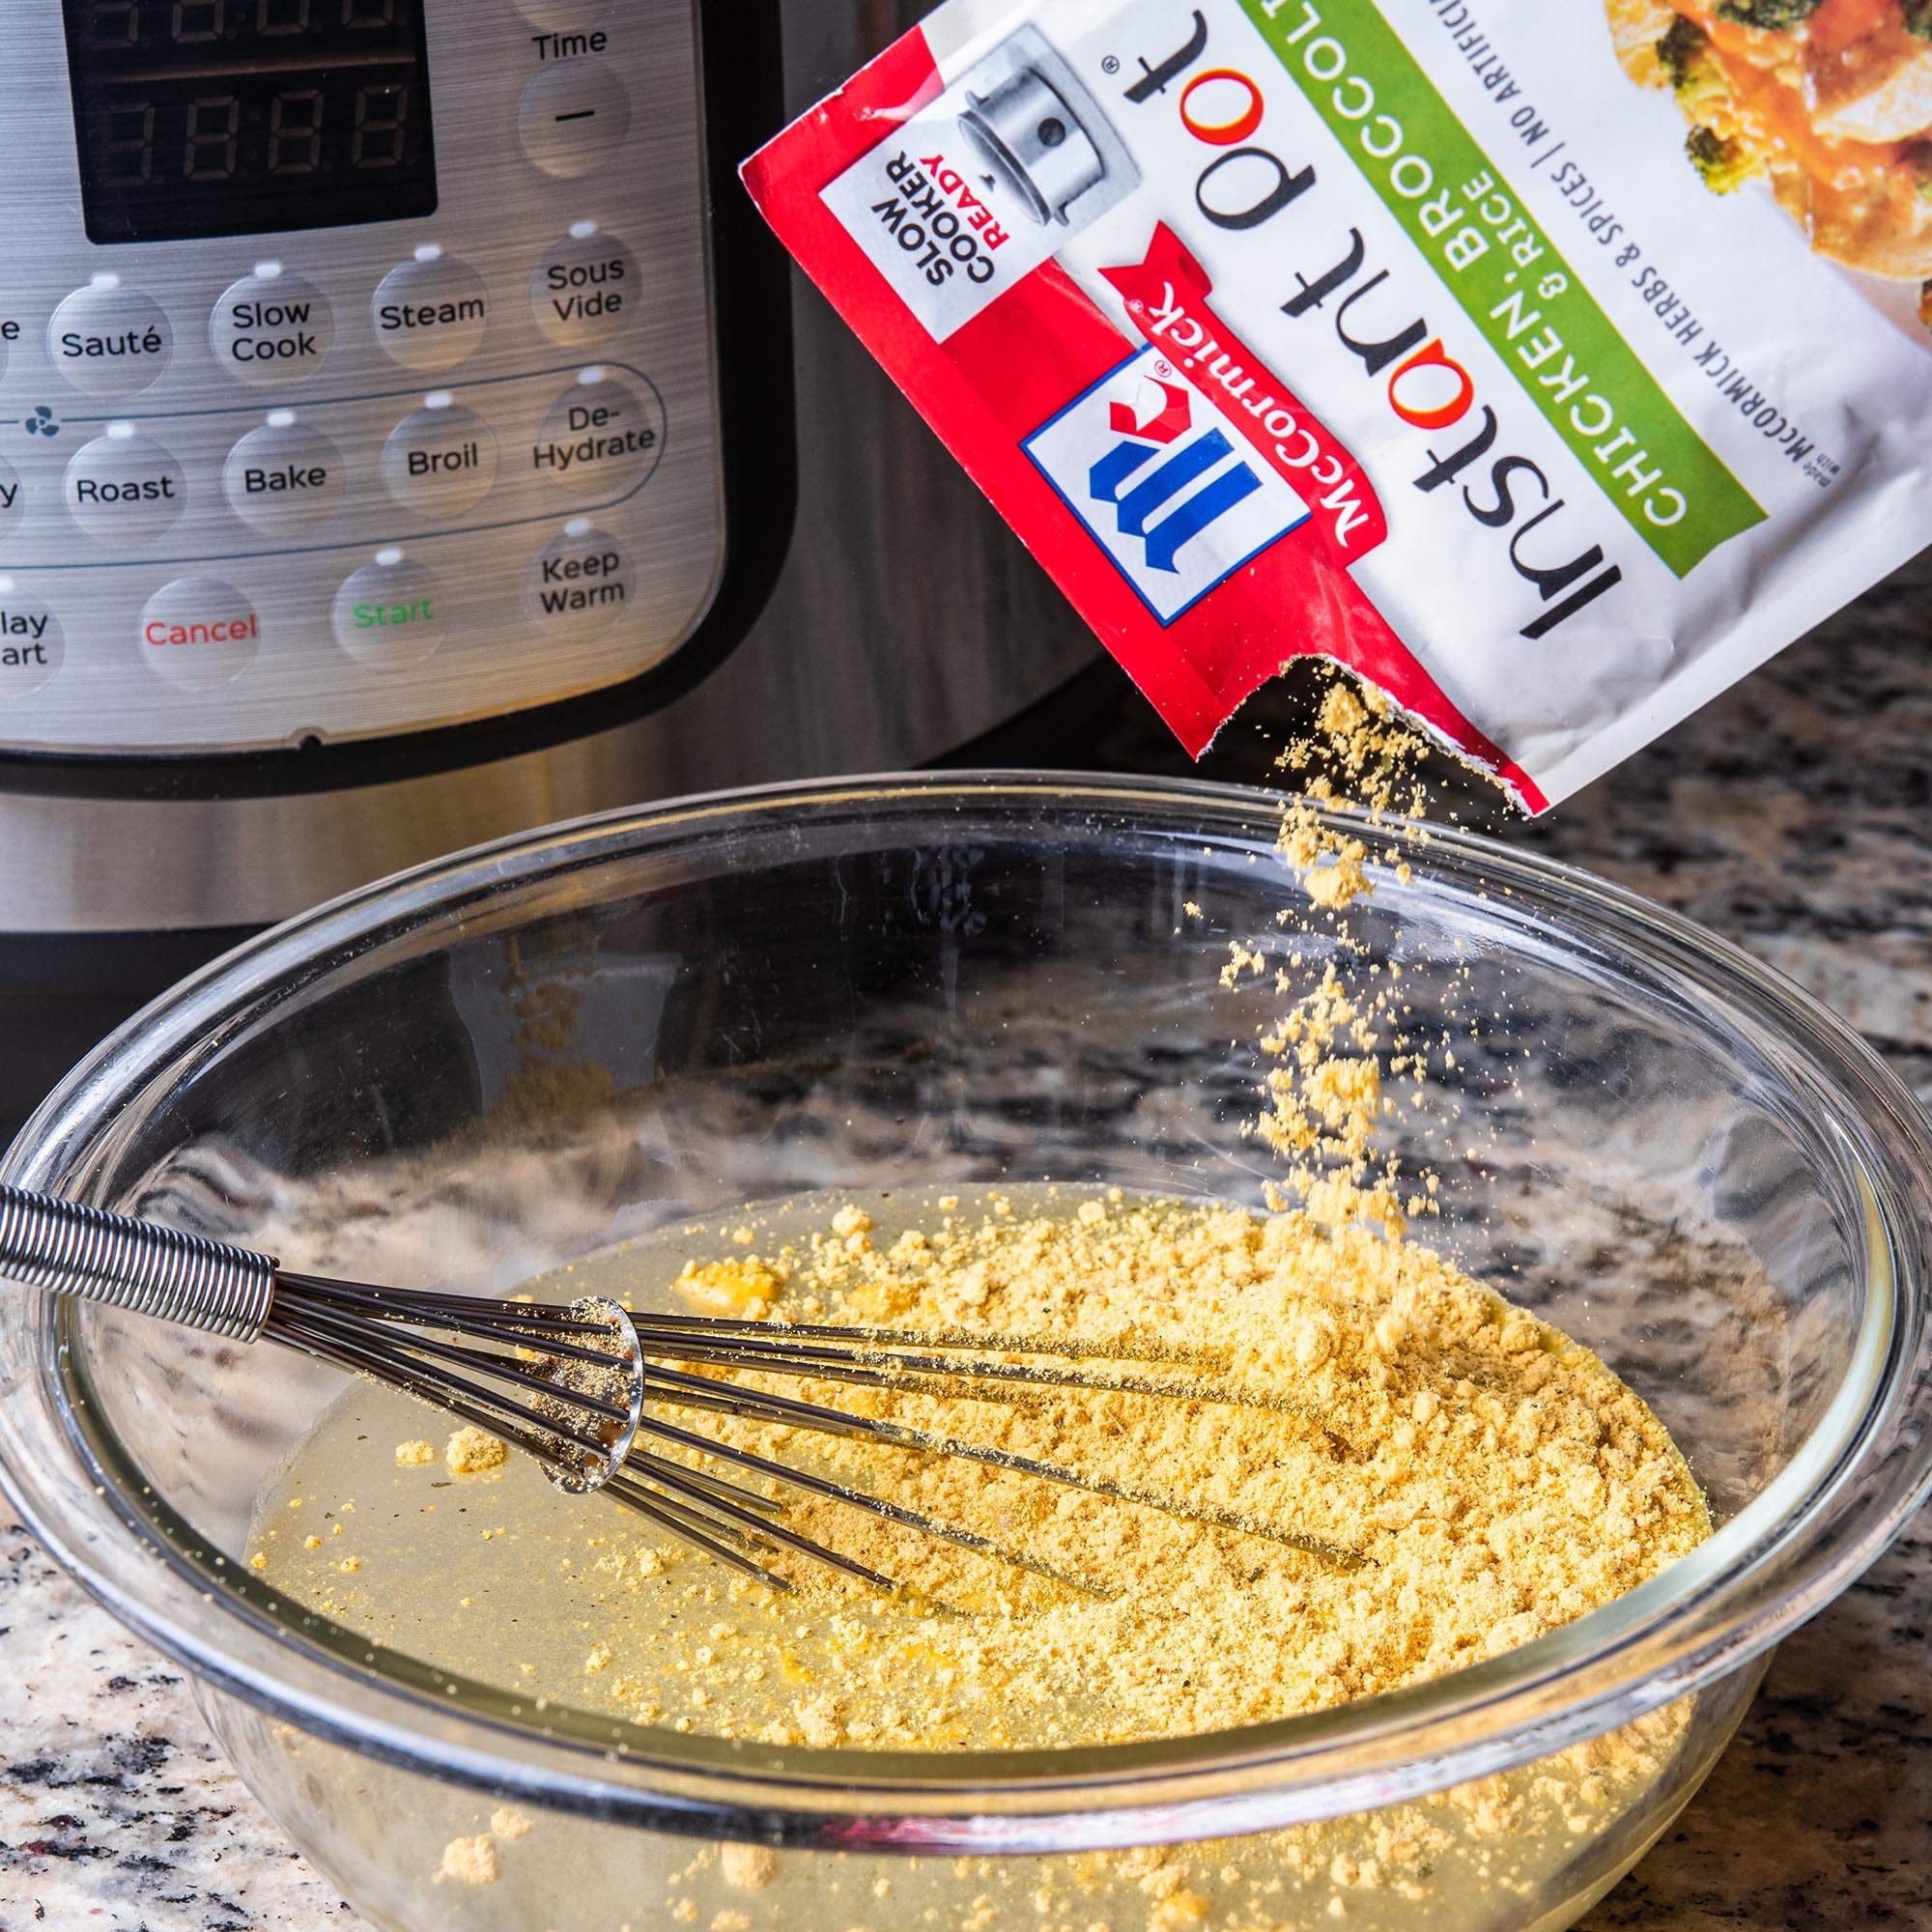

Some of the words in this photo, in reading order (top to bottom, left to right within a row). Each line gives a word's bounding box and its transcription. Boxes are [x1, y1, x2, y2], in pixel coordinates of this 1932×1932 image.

[531, 31, 608, 61] Time
[1429, 0, 1521, 103] ARTIFICI
[1123, 9, 1317, 231] pot
[1510, 106, 1548, 147] NO
[885, 150, 995, 283] COOKER
[919, 154, 1009, 251] READY
[1550, 161, 1624, 244] SPICES
[1462, 170, 1544, 268] RICE
[870, 197, 953, 286] SLOW
[1615, 242, 1640, 268] &
[547, 259, 625, 291] Sous
[1538, 271, 1568, 299] &
[232, 302, 311, 329] Slow
[380, 297, 485, 330] Steam
[553, 291, 623, 322] Vide
[1631, 267, 1703, 346] HERBS
[61, 326, 162, 358] Sauté
[232, 332, 317, 361] Cook
[569, 406, 621, 432] De-
[1149, 281, 1370, 548] McCormick
[1280, 227, 1622, 639] Instant
[408, 442, 478, 475] Broil
[532, 428, 656, 471] Hydrate
[77, 475, 176, 502] Roast
[244, 465, 327, 493] Bake
[542, 551, 620, 583] Keep
[354, 598, 435, 629] Start
[540, 582, 625, 614] Warm
[146, 614, 257, 646] Cancel
